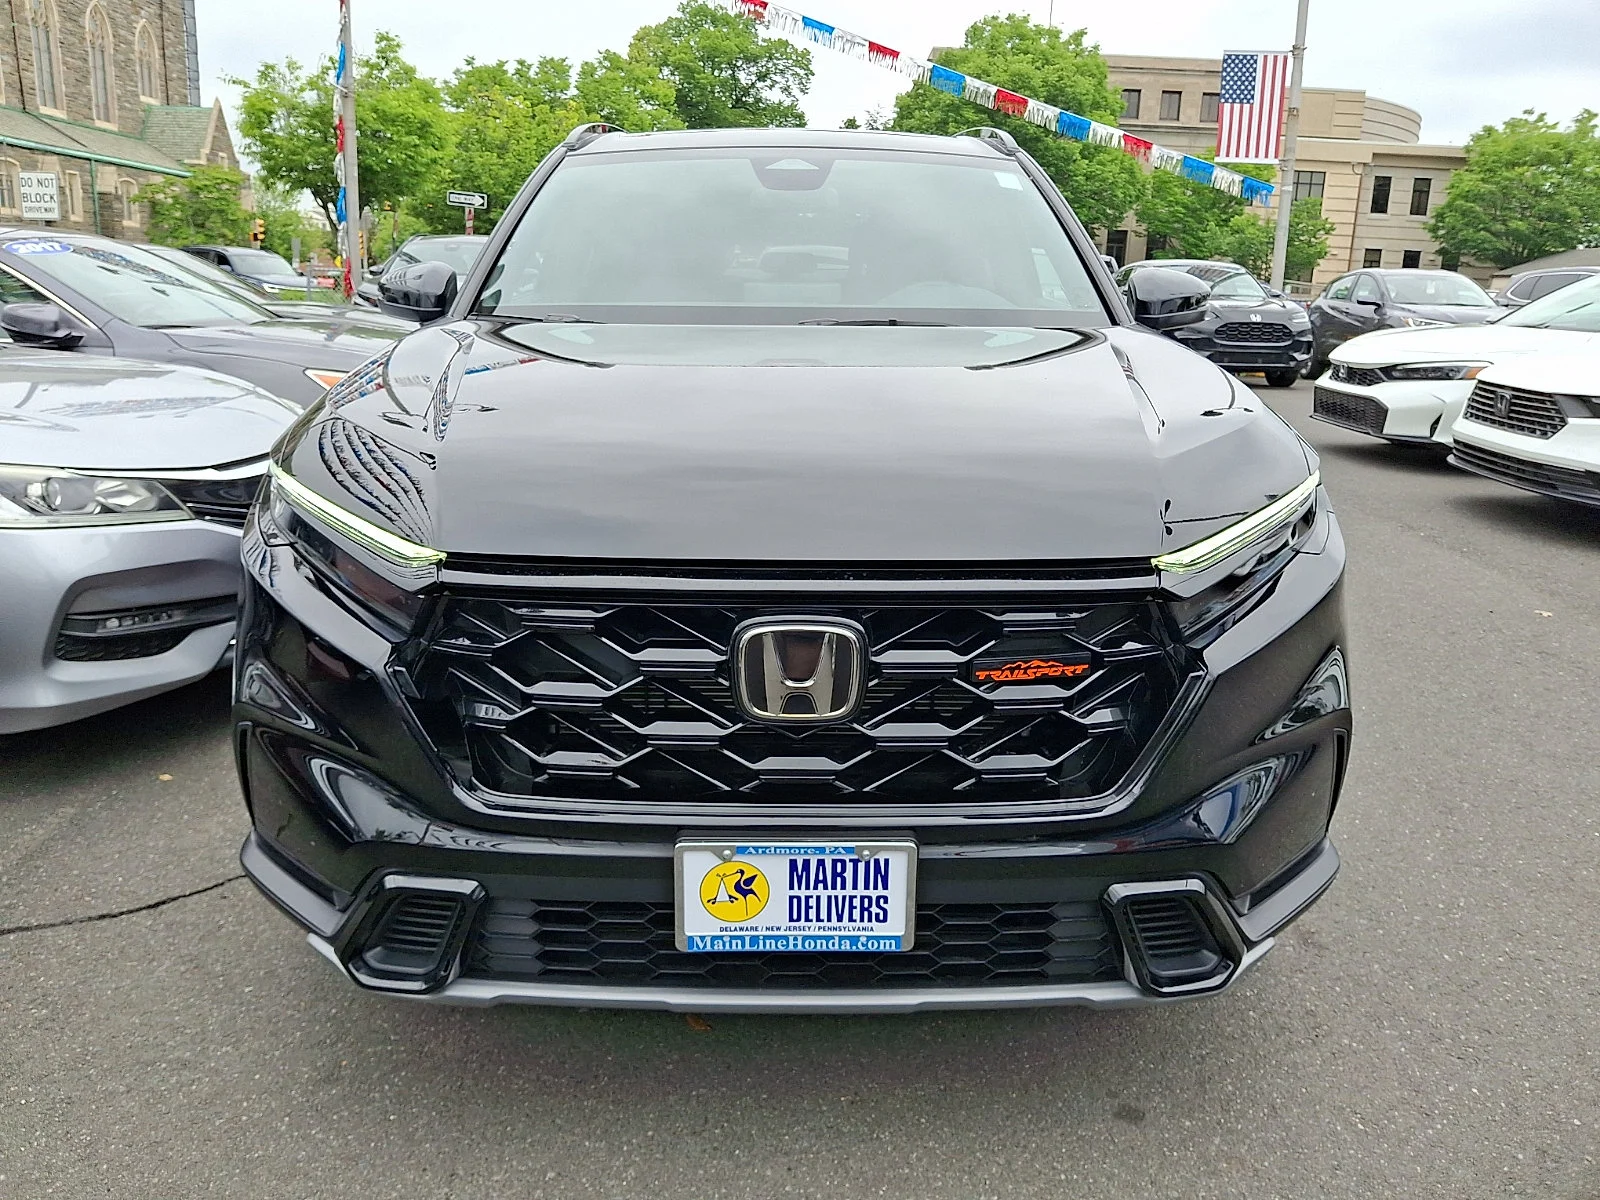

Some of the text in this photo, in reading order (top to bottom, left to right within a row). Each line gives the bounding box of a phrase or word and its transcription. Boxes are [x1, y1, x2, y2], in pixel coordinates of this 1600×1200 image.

[21, 177, 54, 188] DO NOT
[22, 192, 57, 204] BLOCK
[11, 241, 63, 254] 2017
[975, 664, 1089, 681] TRAILSPORT
[825, 846, 847, 855] PA
[788, 858, 890, 891] MARTIN
[788, 894, 889, 924] DELIVERS
[691, 935, 897, 951] MainLineHonda.com
